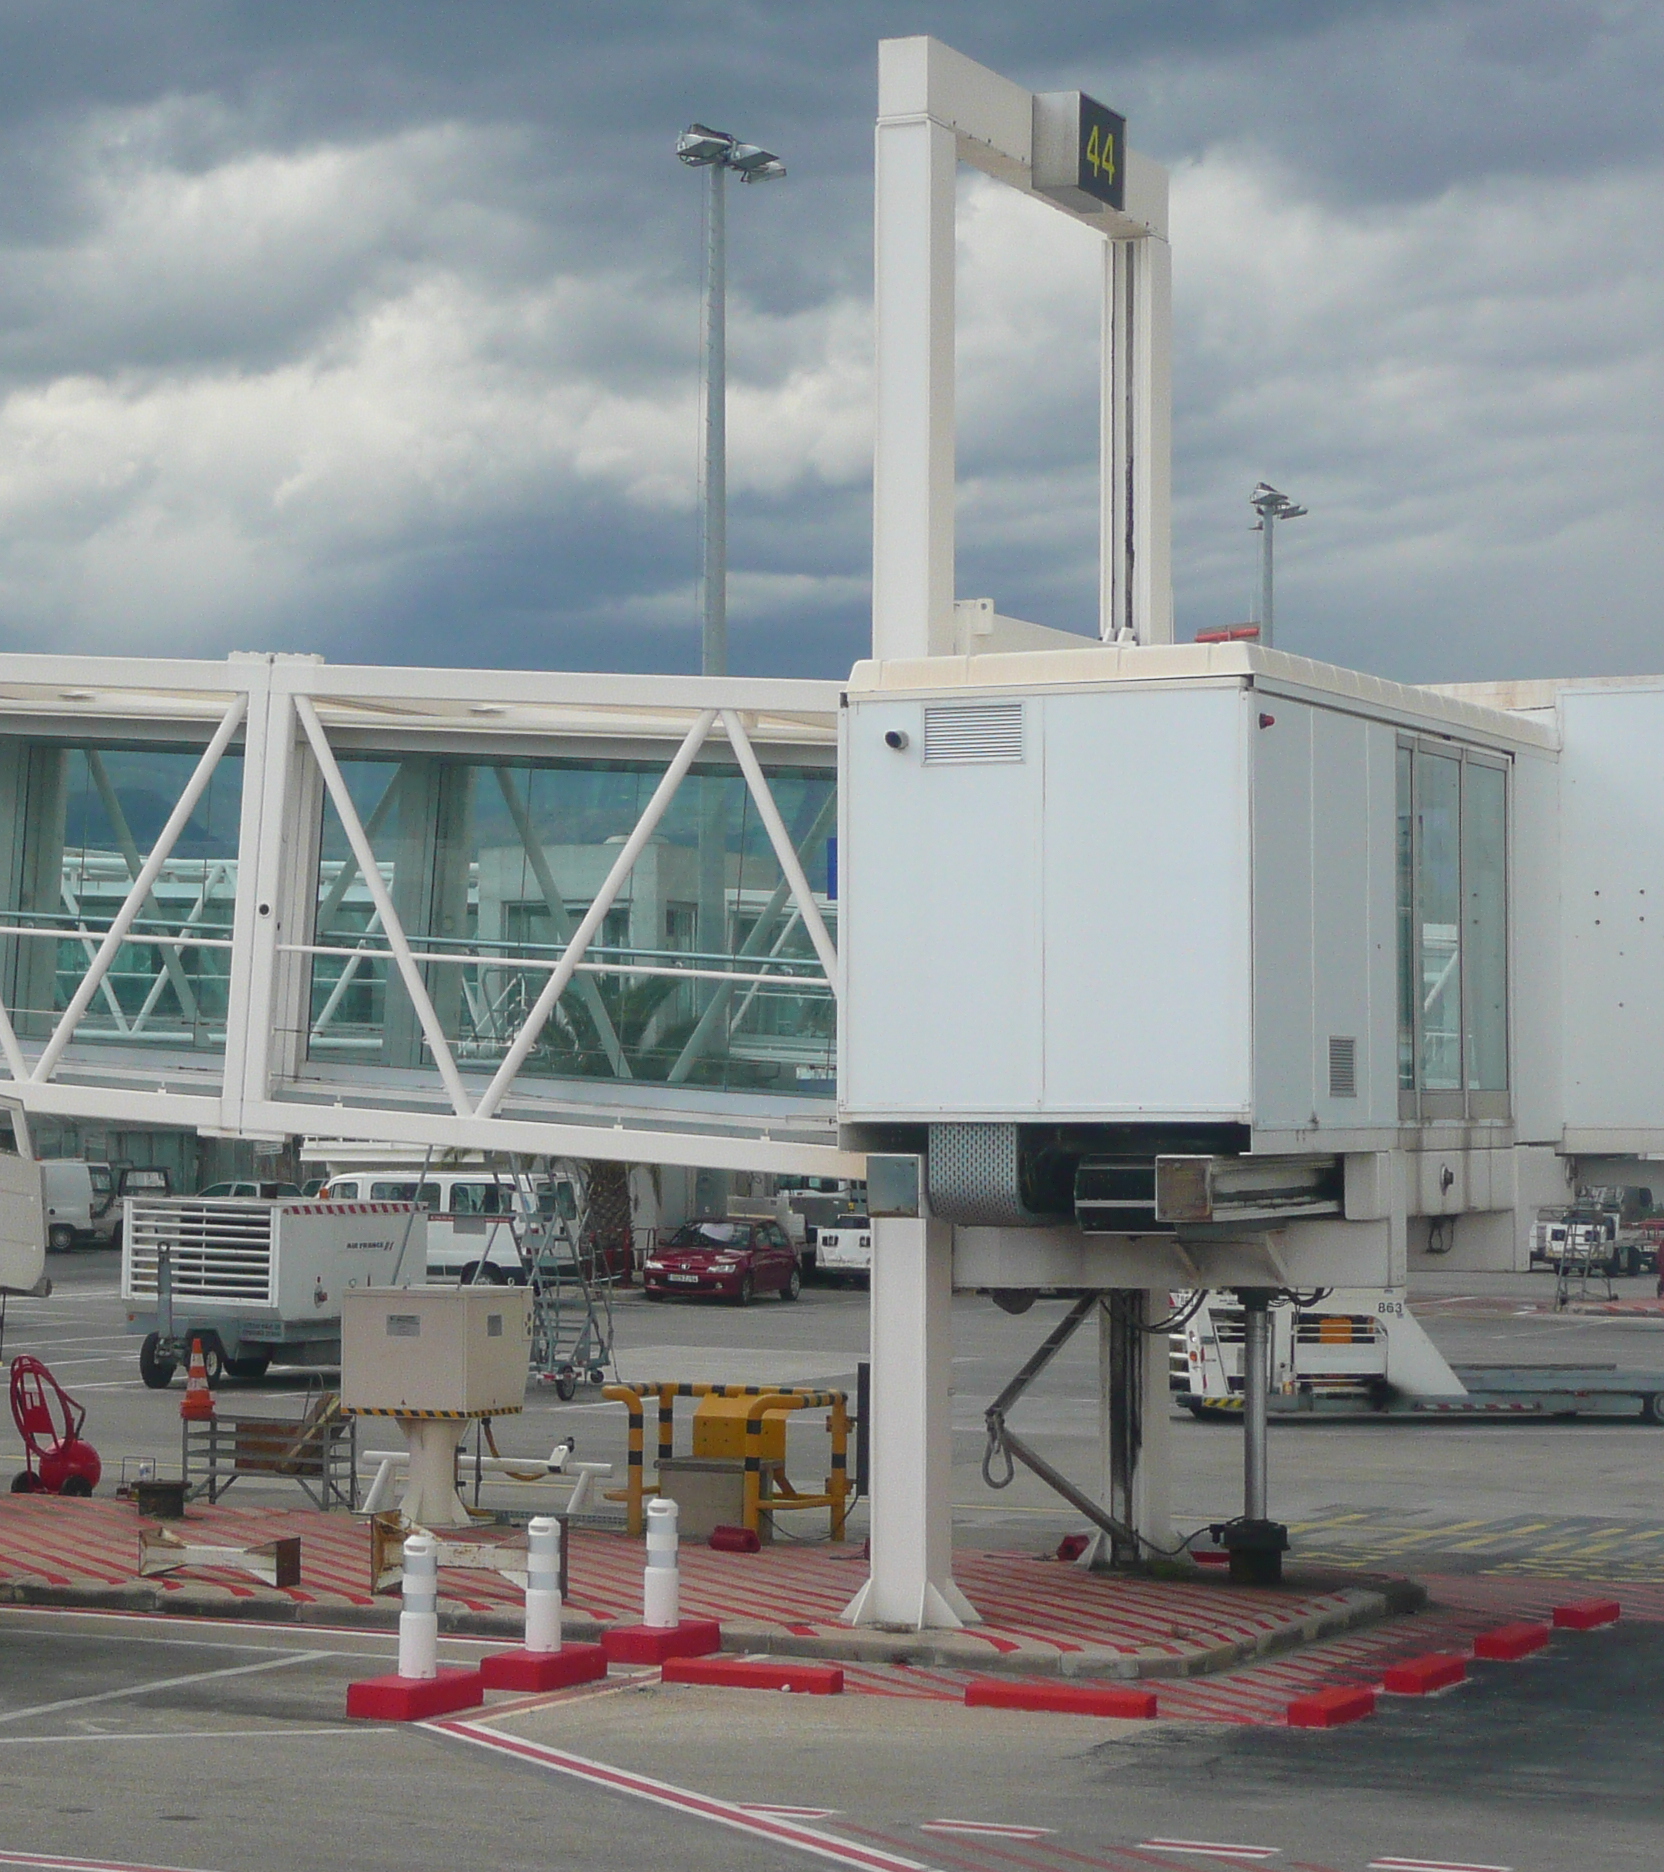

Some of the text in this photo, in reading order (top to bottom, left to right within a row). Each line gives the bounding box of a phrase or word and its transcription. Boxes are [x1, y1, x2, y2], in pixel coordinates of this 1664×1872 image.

[1086, 124, 1116, 186] 44
[359, 1241, 384, 1249] FRANCE
[1377, 1302, 1403, 1314] 863
